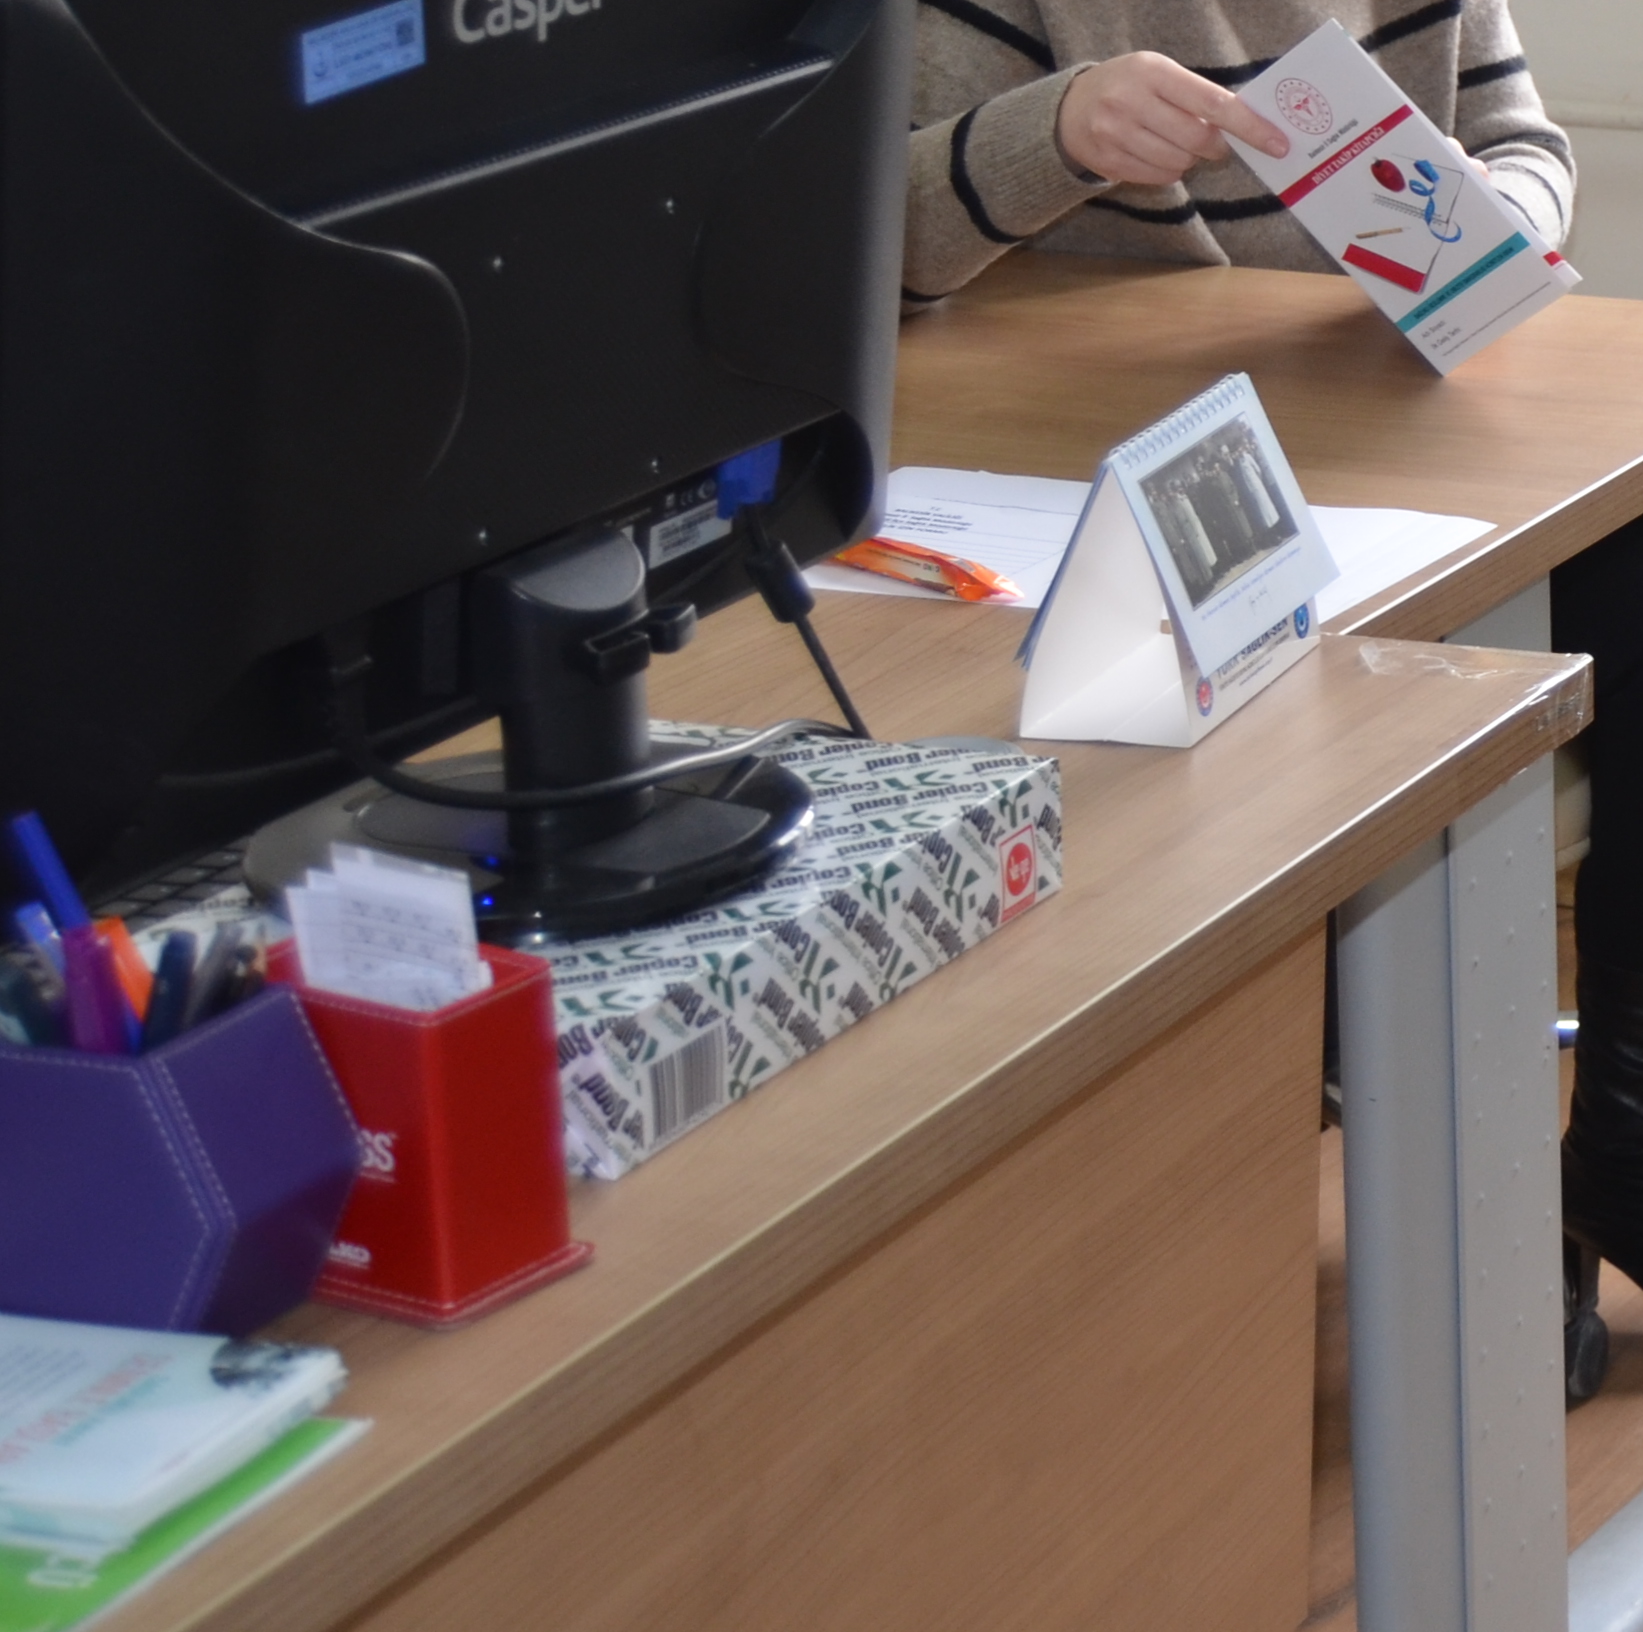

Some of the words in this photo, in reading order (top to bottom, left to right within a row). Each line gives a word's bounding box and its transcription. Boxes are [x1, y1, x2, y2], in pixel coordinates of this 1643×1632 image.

[865, 752, 920, 771] Bond
[972, 756, 1028, 773] Bond
[913, 781, 988, 801] Copier
[851, 794, 907, 813] Bond
[836, 837, 895, 856] Bond
[613, 955, 698, 976] Copier
